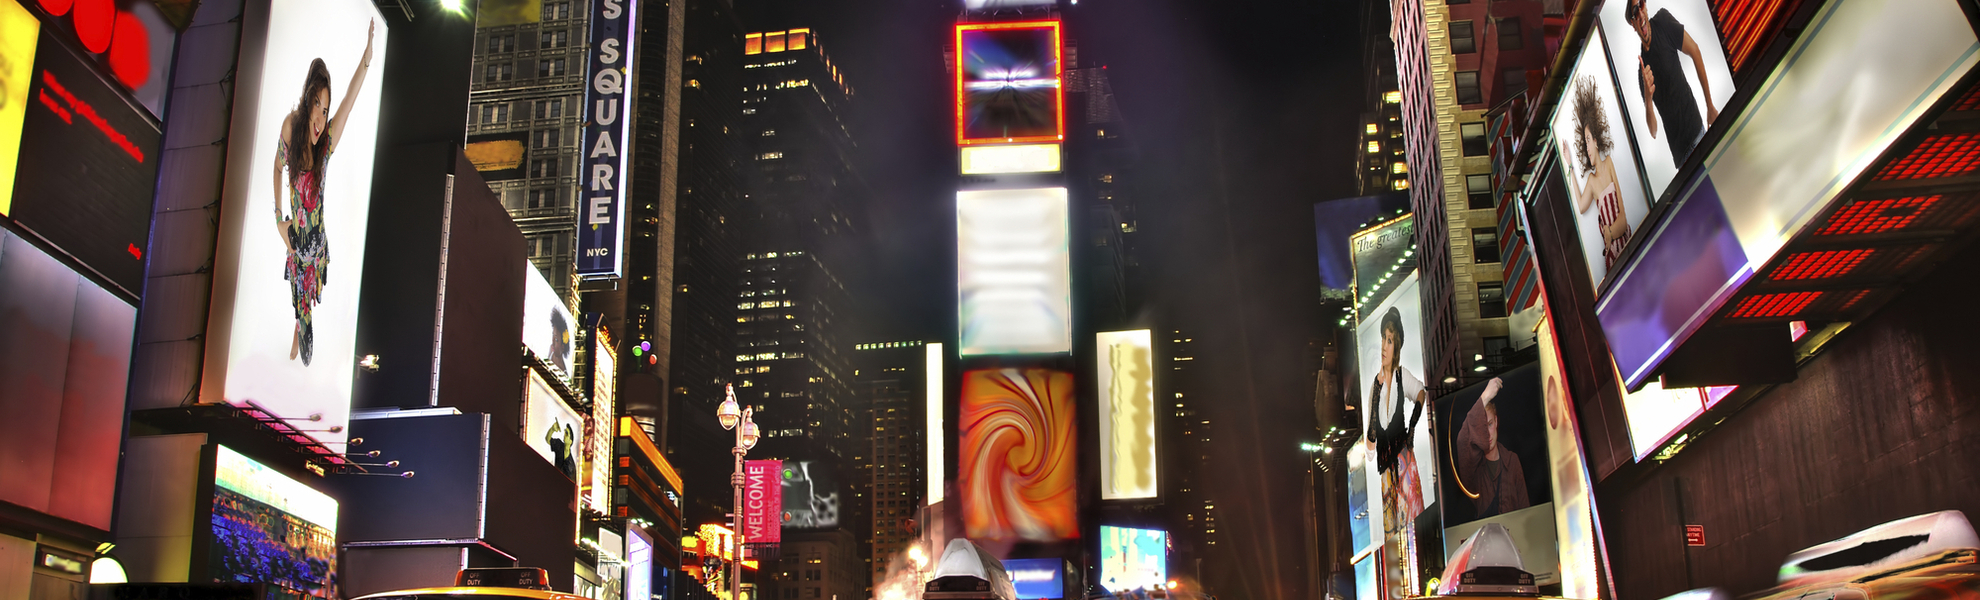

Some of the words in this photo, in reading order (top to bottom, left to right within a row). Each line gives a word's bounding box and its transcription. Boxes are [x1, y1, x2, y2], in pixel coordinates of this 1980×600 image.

[589, 38, 622, 225] SQUARE
[586, 248, 608, 257] NYC
[1357, 236, 1374, 252] The
[1377, 224, 1413, 250] greatest
[748, 466, 764, 540] WELCOME
